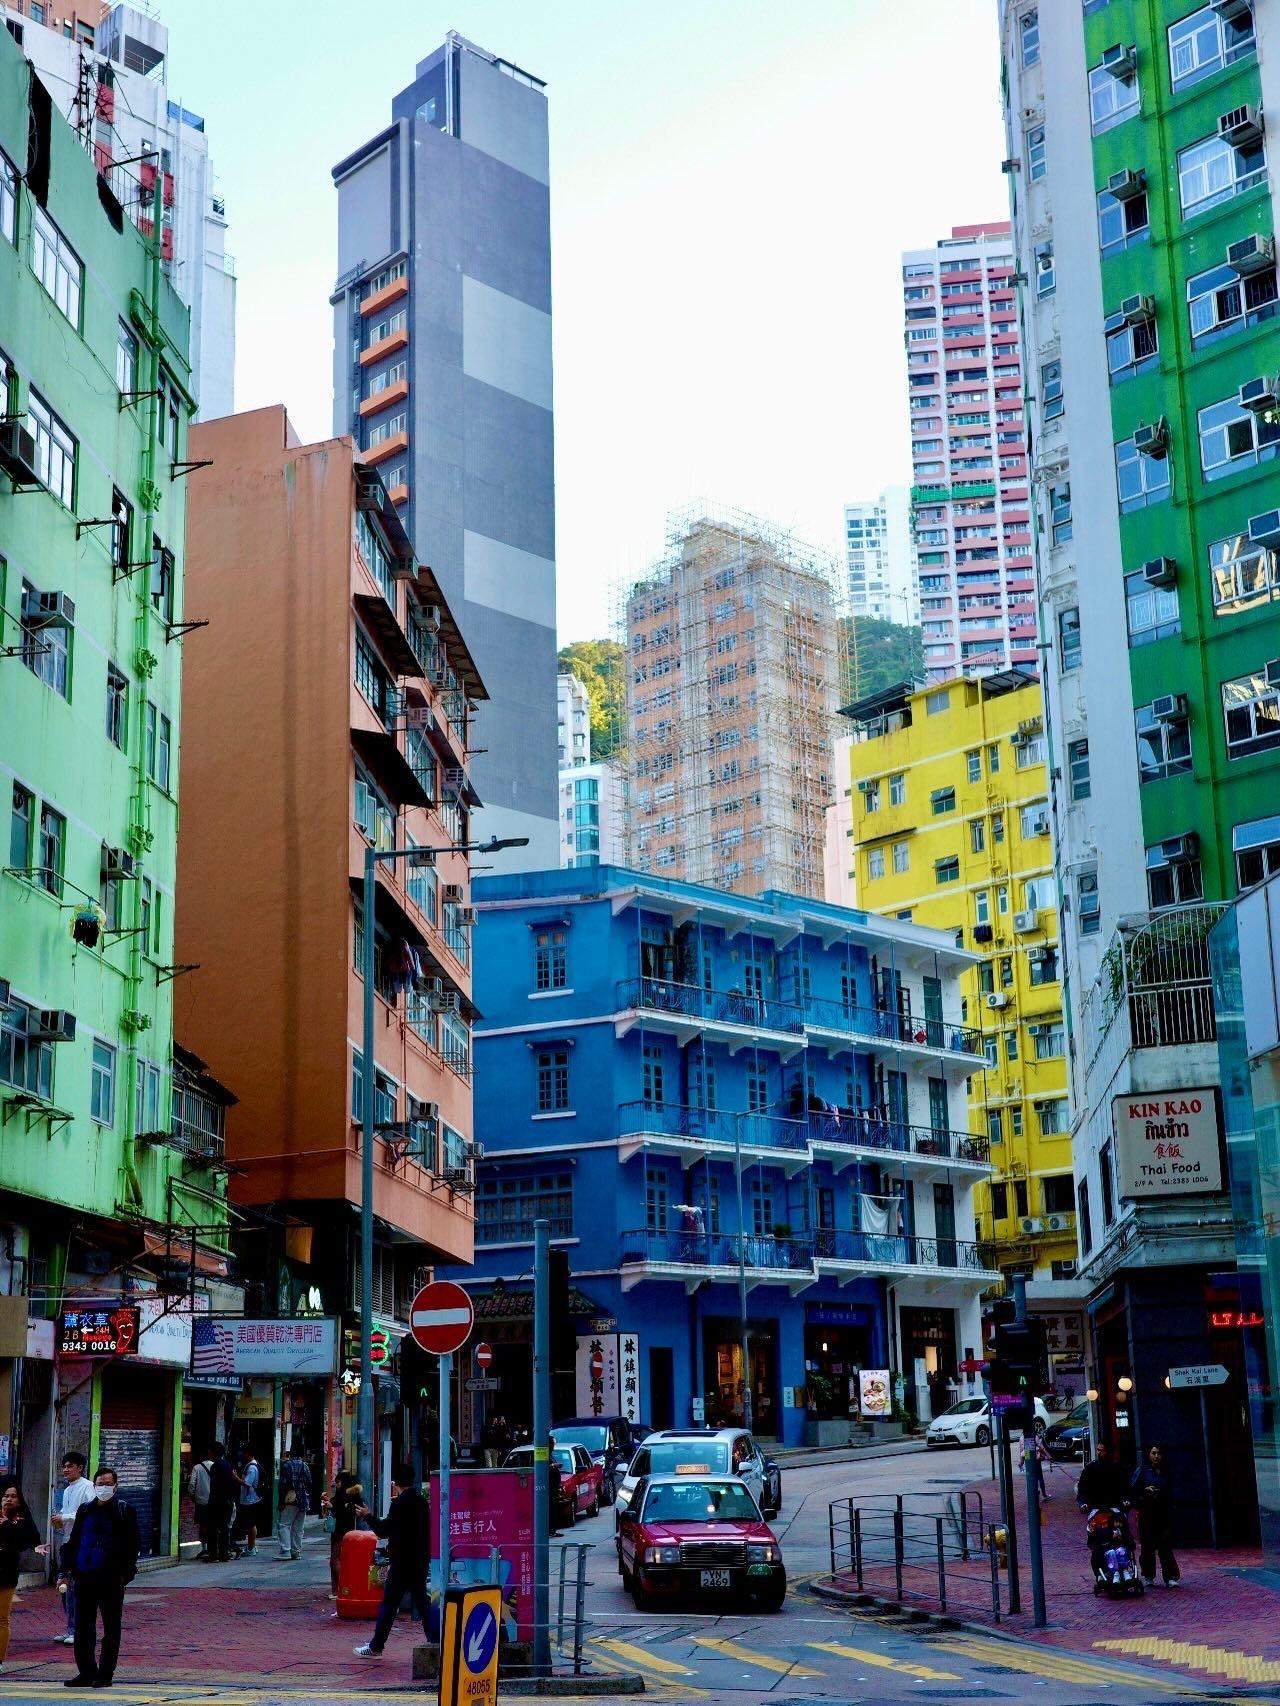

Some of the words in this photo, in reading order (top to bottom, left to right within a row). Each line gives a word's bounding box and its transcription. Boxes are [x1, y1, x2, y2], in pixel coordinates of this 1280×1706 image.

[1129, 1102, 1160, 1119] KIN
[1164, 1099, 1202, 1117] KAO
[1153, 1143, 1184, 1160] 食飯
[1140, 1163, 1167, 1176] Thai
[1172, 1161, 1201, 1174] Food
[237, 1324, 323, 1344] 美國優質乾洗專門店
[62, 1341, 87, 1351] 9343
[91, 1340, 117, 1351] 0016
[450, 1520, 497, 1535] 注意行人
[709, 1570, 722, 1579] VN
[703, 1578, 728, 1587] 2469
